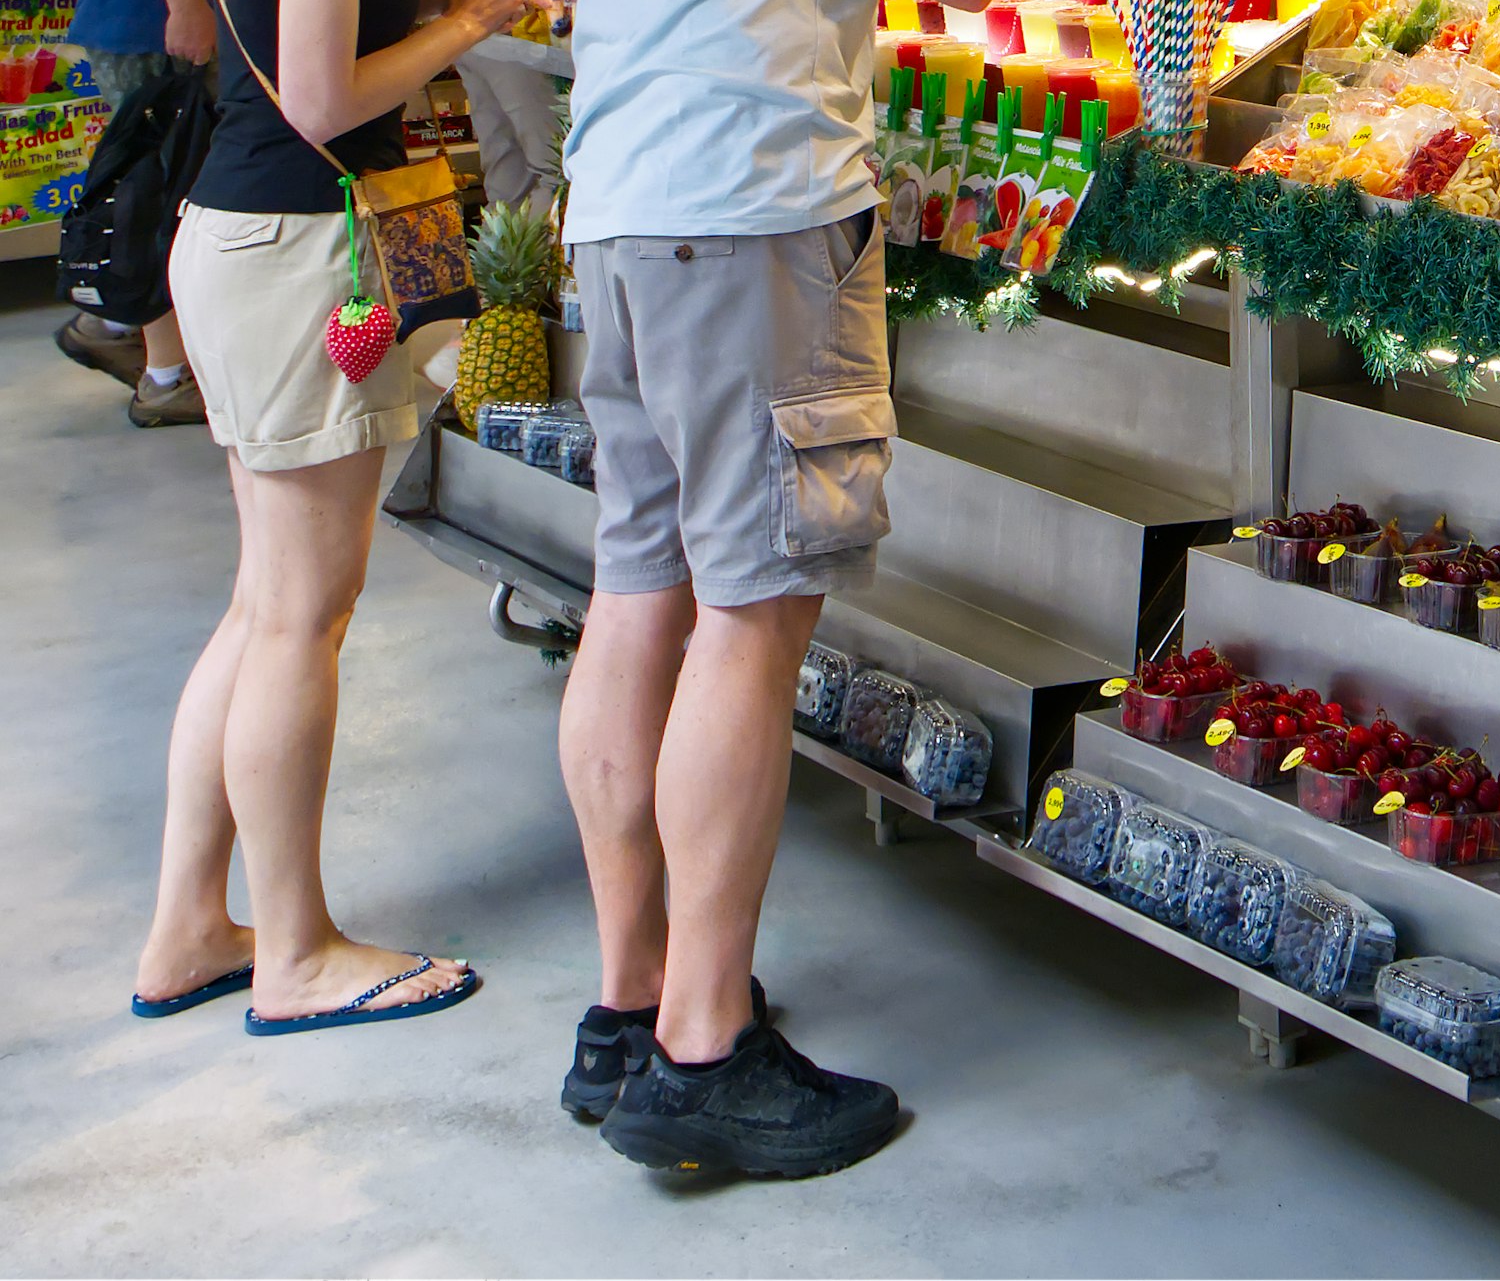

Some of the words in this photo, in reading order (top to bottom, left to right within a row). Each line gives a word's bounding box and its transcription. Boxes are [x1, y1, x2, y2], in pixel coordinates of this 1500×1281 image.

[63, 101, 113, 119] Fruta
[1310, 121, 1331, 132] 1,99€
[15, 121, 74, 151] salad
[30, 153, 52, 165] The
[56, 147, 82, 160] Best
